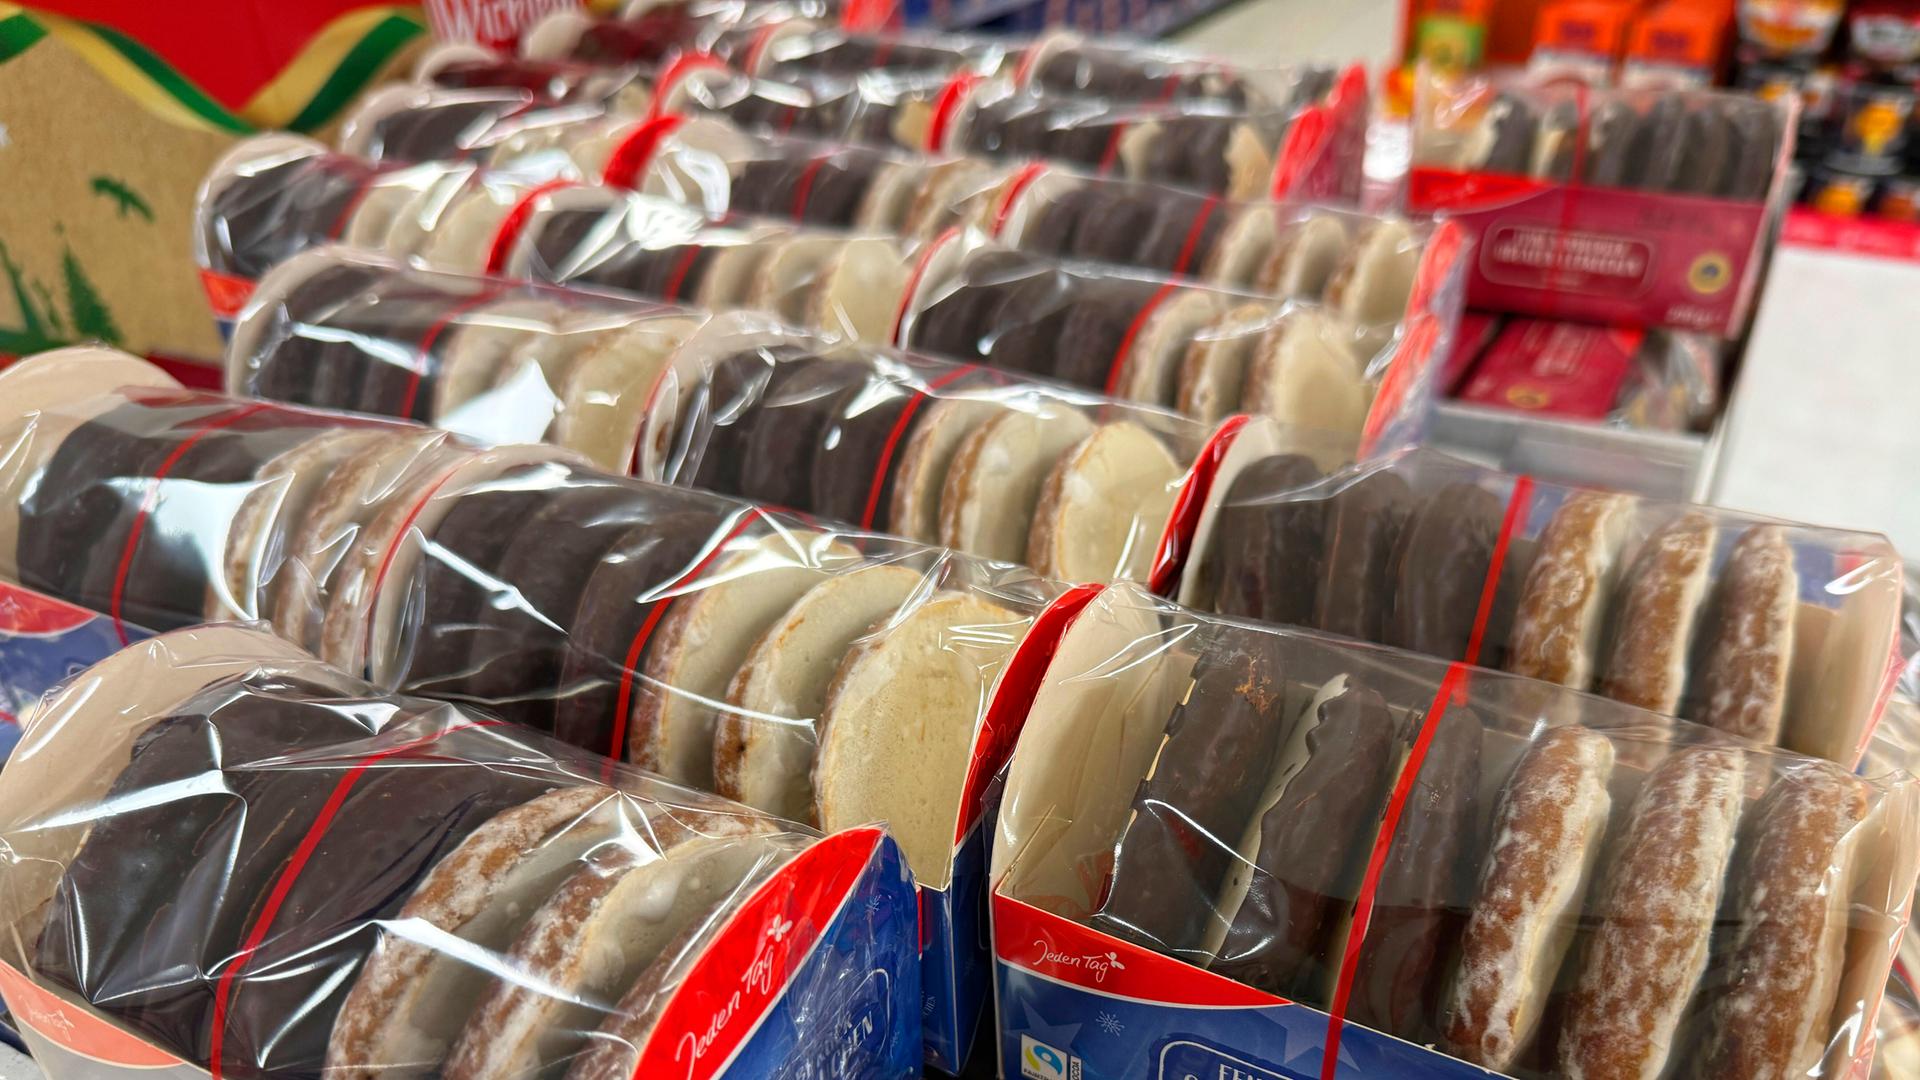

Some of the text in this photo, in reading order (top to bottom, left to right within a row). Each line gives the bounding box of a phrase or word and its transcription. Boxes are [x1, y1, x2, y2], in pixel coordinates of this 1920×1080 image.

[1032, 939, 1109, 983] Jeden Tag
[675, 942, 774, 1080] Jeden Tag
